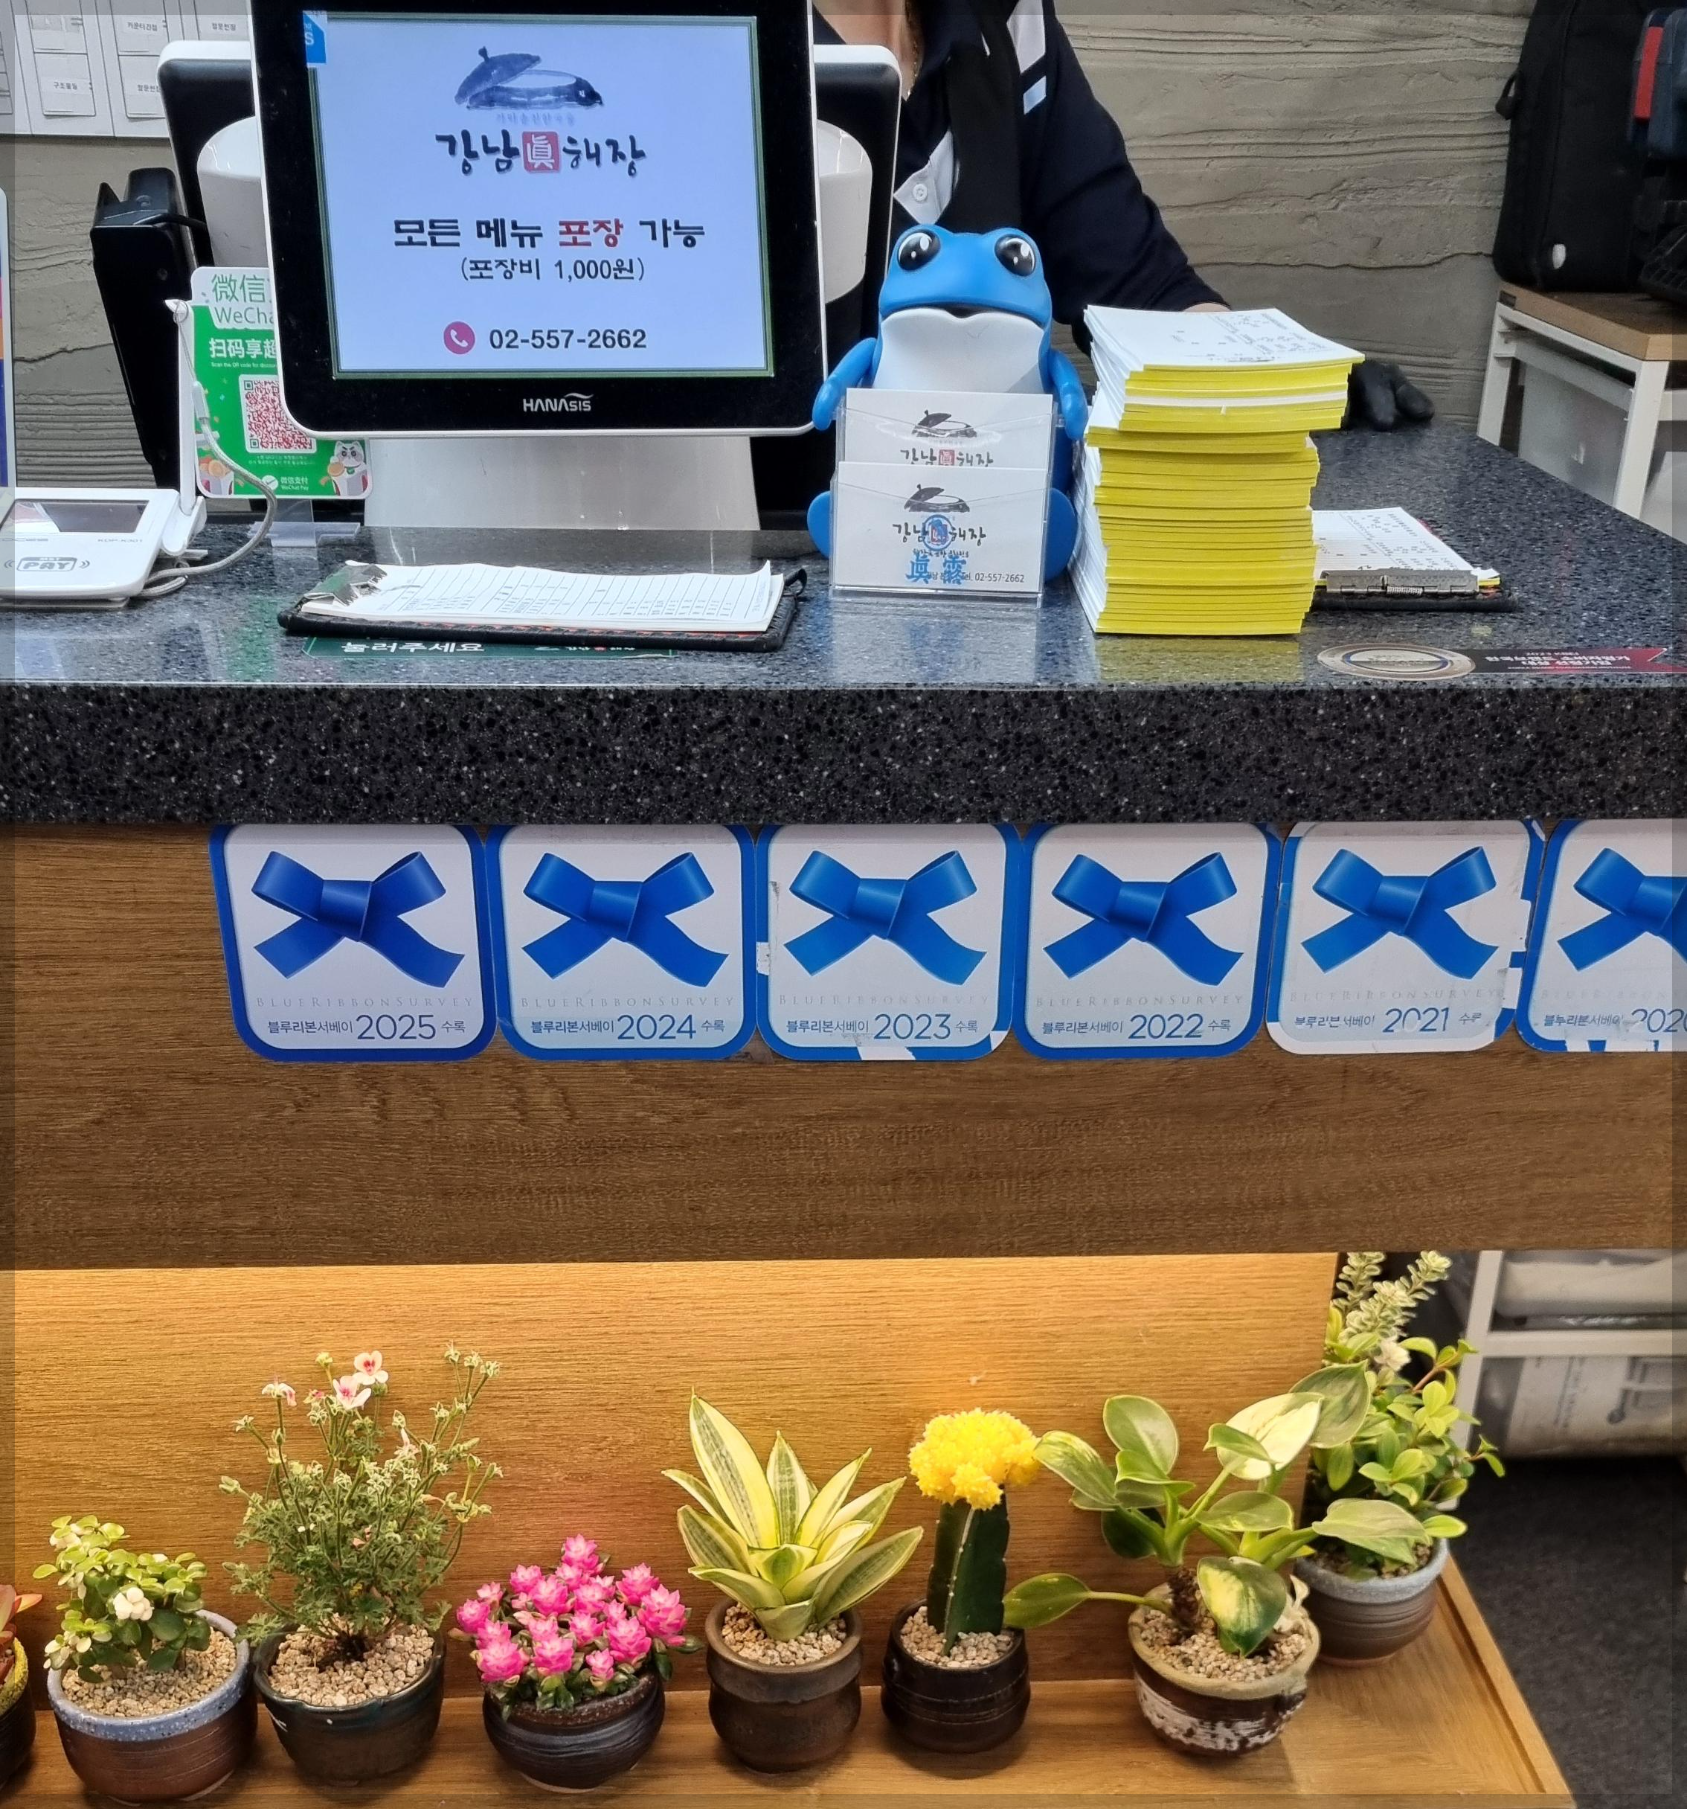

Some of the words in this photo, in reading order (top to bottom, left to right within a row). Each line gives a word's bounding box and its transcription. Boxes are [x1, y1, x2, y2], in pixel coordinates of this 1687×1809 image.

[435, 128, 646, 177] 강남眞해장
[394, 219, 461, 247] 모든
[476, 218, 543, 248] 메뉴
[558, 218, 624, 248] 포장
[639, 218, 705, 248] 가능
[461, 257, 541, 281] (포장비
[554, 257, 645, 281] 1,000원)
[489, 328, 647, 349] 02-557-2662
[522, 392, 595, 412] HANASIS
[22, 561, 71, 570] PAY
[974, 572, 1025, 583] 02-557-2662
[267, 1020, 353, 1034] 블루리본서베이
[355, 1014, 437, 1040] 2025
[441, 1021, 466, 1032] 수록
[531, 1020, 614, 1034] 블루리본서베이
[617, 1014, 697, 1040] 2024
[701, 1020, 725, 1032] 수록
[786, 1020, 869, 1033] 블루리본서베이
[873, 1013, 952, 1040] 2023
[955, 1020, 979, 1032] 수록
[1042, 1020, 1124, 1034] 블루리본서베이
[1128, 1013, 1204, 1039] 2022
[1207, 1019, 1232, 1032] 수록
[1382, 1007, 1450, 1033] 2021
